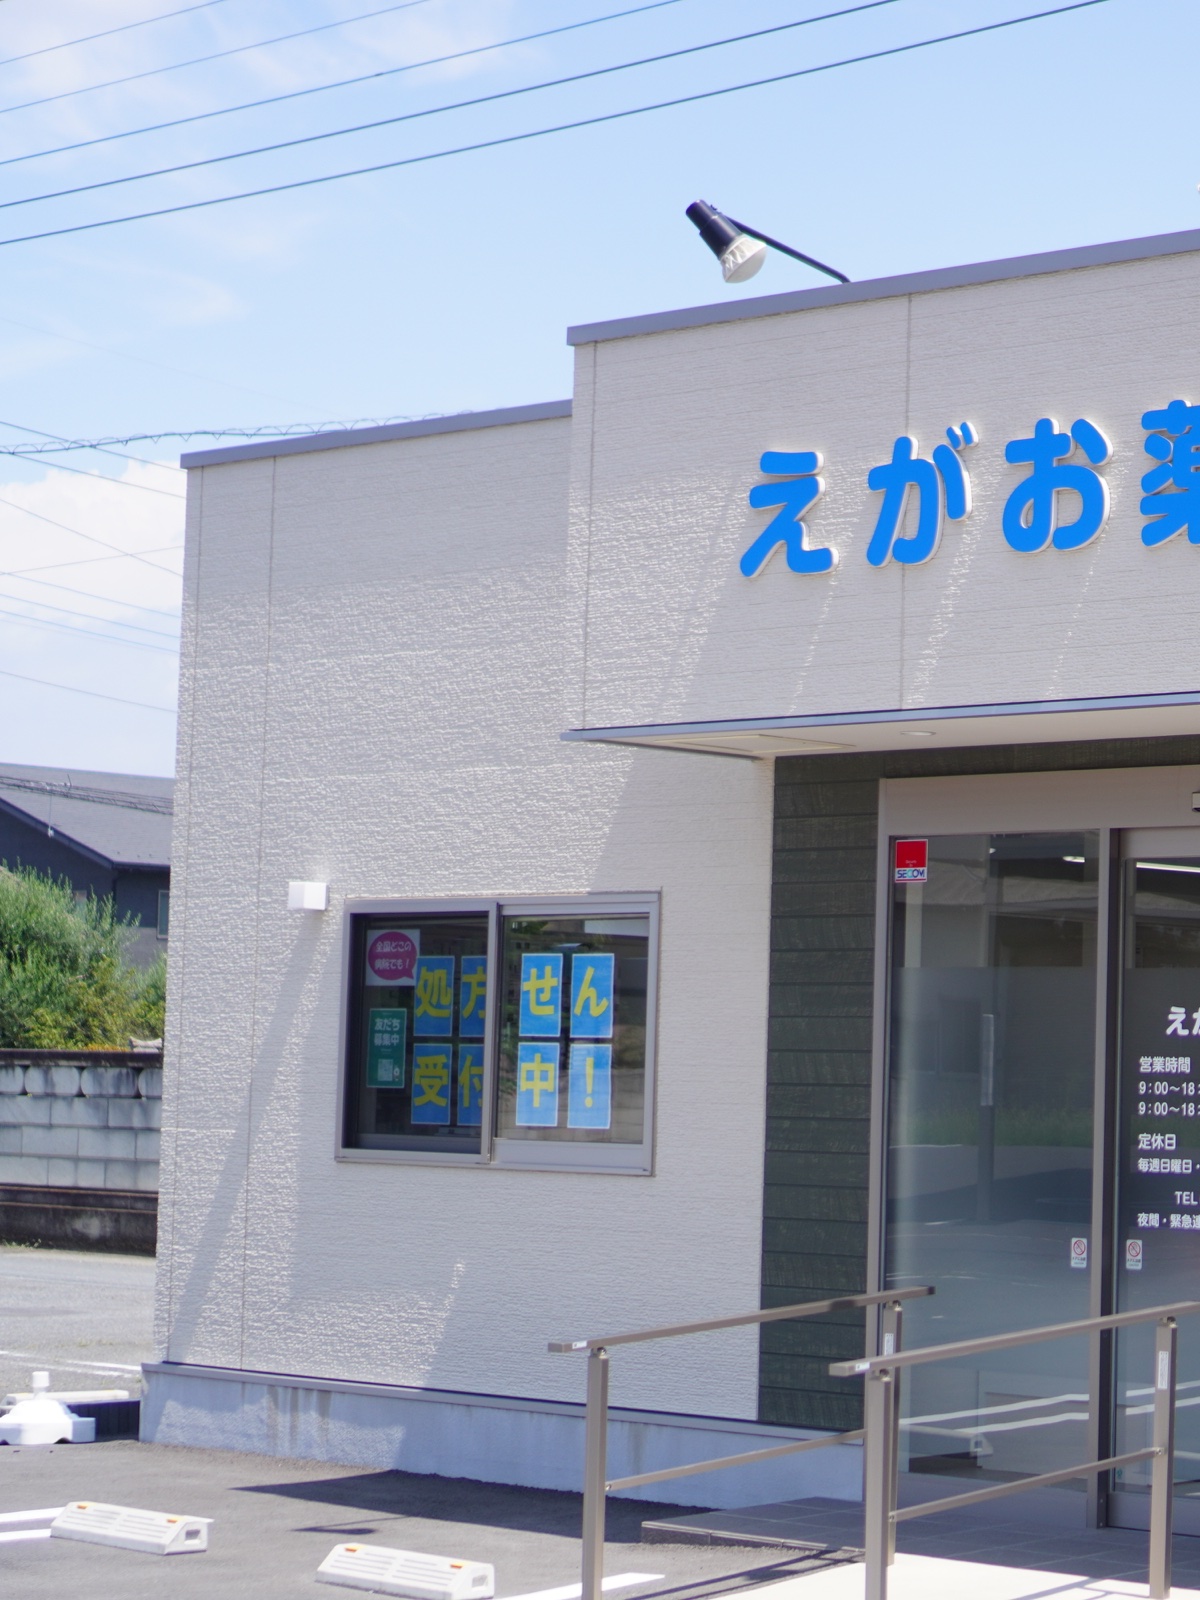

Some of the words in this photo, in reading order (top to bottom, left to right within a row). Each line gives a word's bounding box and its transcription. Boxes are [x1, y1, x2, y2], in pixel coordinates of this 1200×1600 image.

[896, 868, 926, 879] SECOM
[374, 1018, 401, 1031] 友だち
[1138, 1056, 1191, 1073] 営業時間
[1138, 1133, 1177, 1150] 定休日
[1174, 1191, 1198, 1205] TEL
